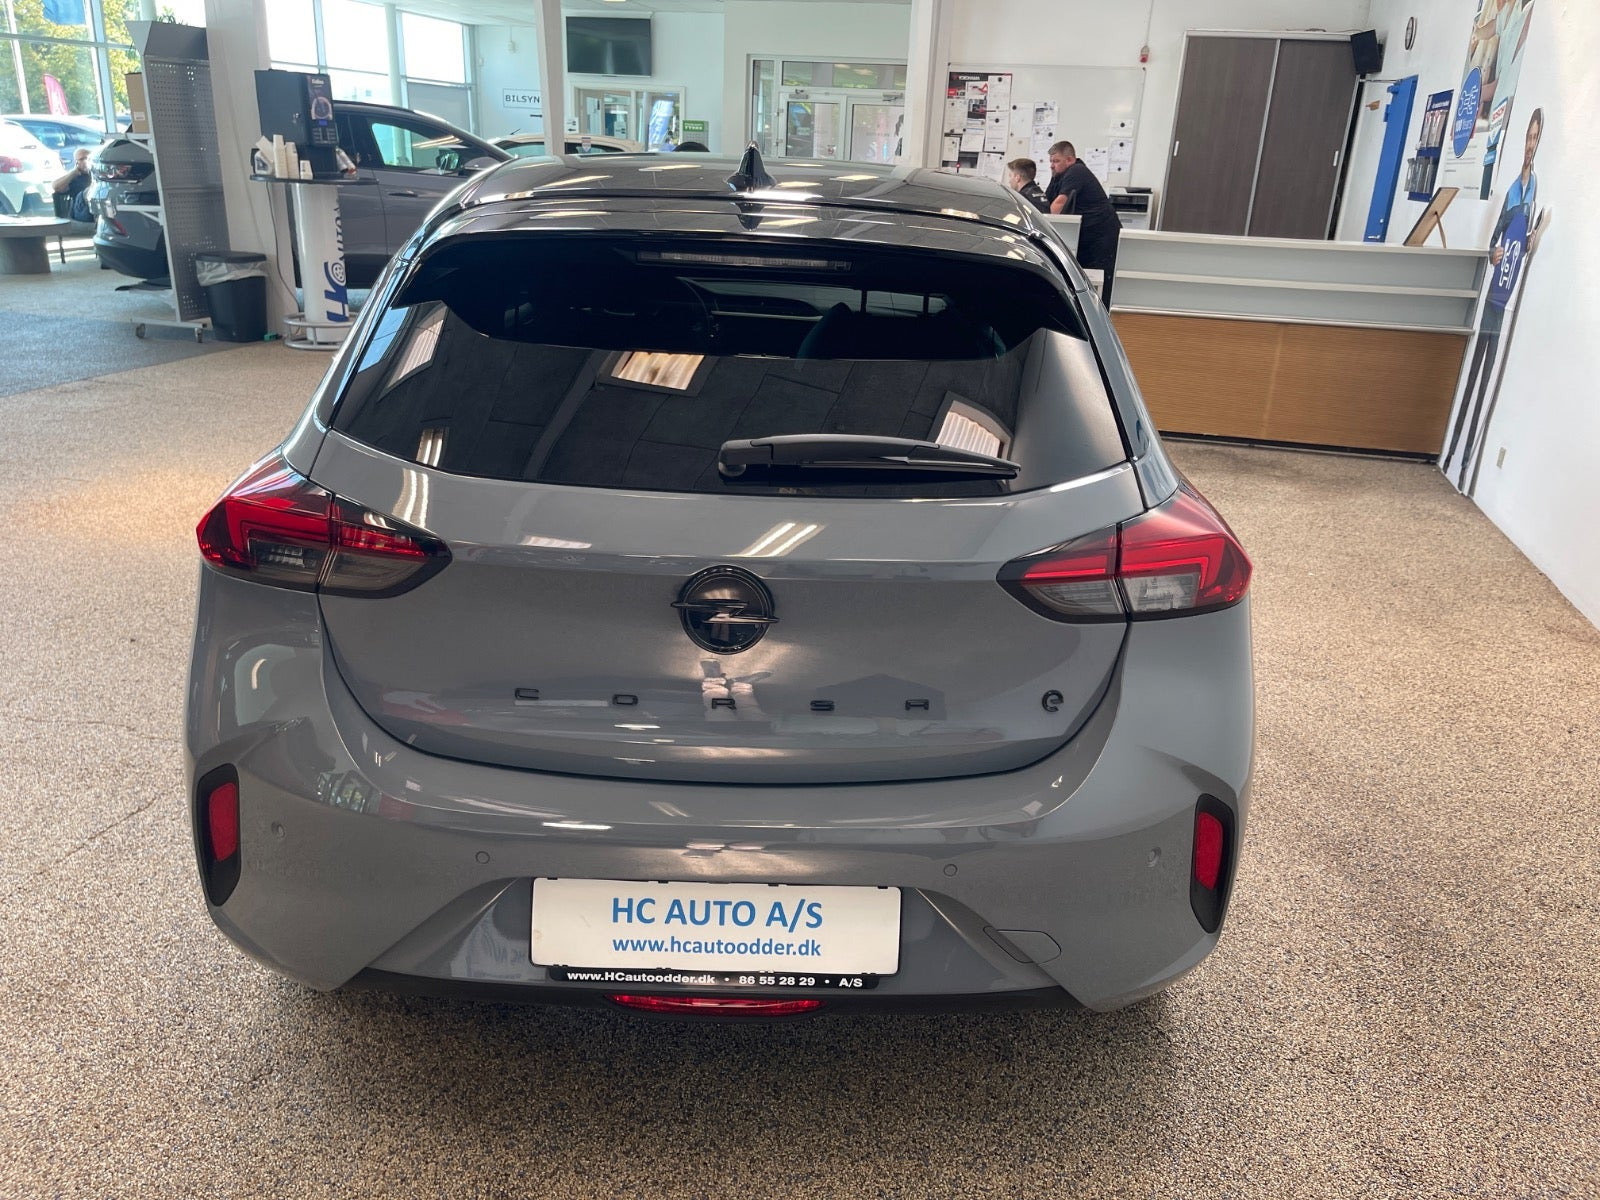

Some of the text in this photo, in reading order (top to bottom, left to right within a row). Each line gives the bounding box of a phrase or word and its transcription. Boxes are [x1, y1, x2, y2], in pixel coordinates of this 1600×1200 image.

[505, 94, 541, 103] BILSYN
[514, 687, 931, 713] CORSA
[1041, 689, 1065, 713] e
[612, 897, 824, 933] HC AUTO A/S
[612, 936, 822, 957] www.hcautoodder.dk
[566, 971, 863, 988] www.HCautoodder.dk 86 55 28 29 A/S
